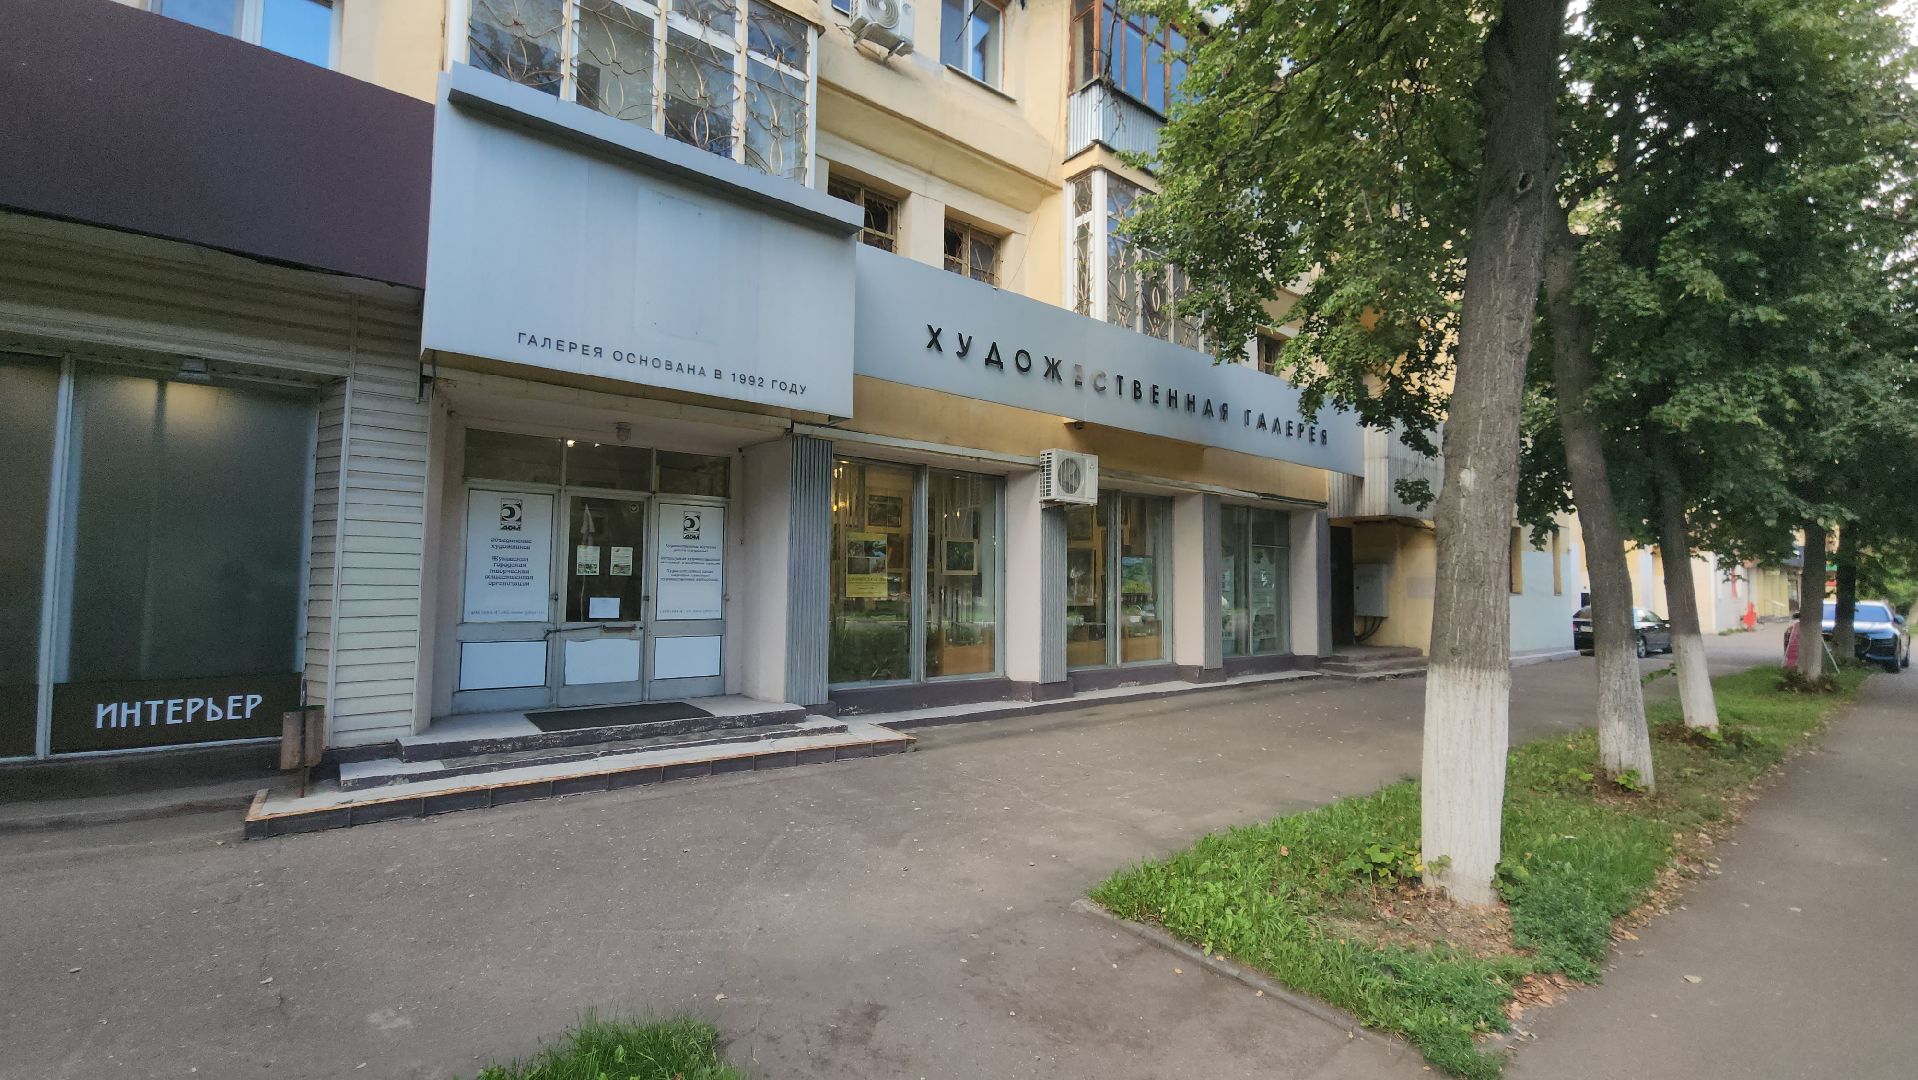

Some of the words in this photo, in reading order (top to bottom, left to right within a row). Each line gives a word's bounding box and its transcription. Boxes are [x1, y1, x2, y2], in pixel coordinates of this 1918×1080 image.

[518, 332, 602, 358] ГАЛЕРЕЯ
[613, 350, 706, 377] ОСНОВАНА
[714, 369, 722, 380] В
[730, 373, 764, 388] 1992
[771, 379, 807, 395] ГОДУ
[926, 324, 1229, 422] ХУДОЖЕСТВЕННАЯ
[1244, 408, 1329, 446] ГАЛЕРЕЯ
[96, 694, 263, 729] ИНТЕРЬЕР
